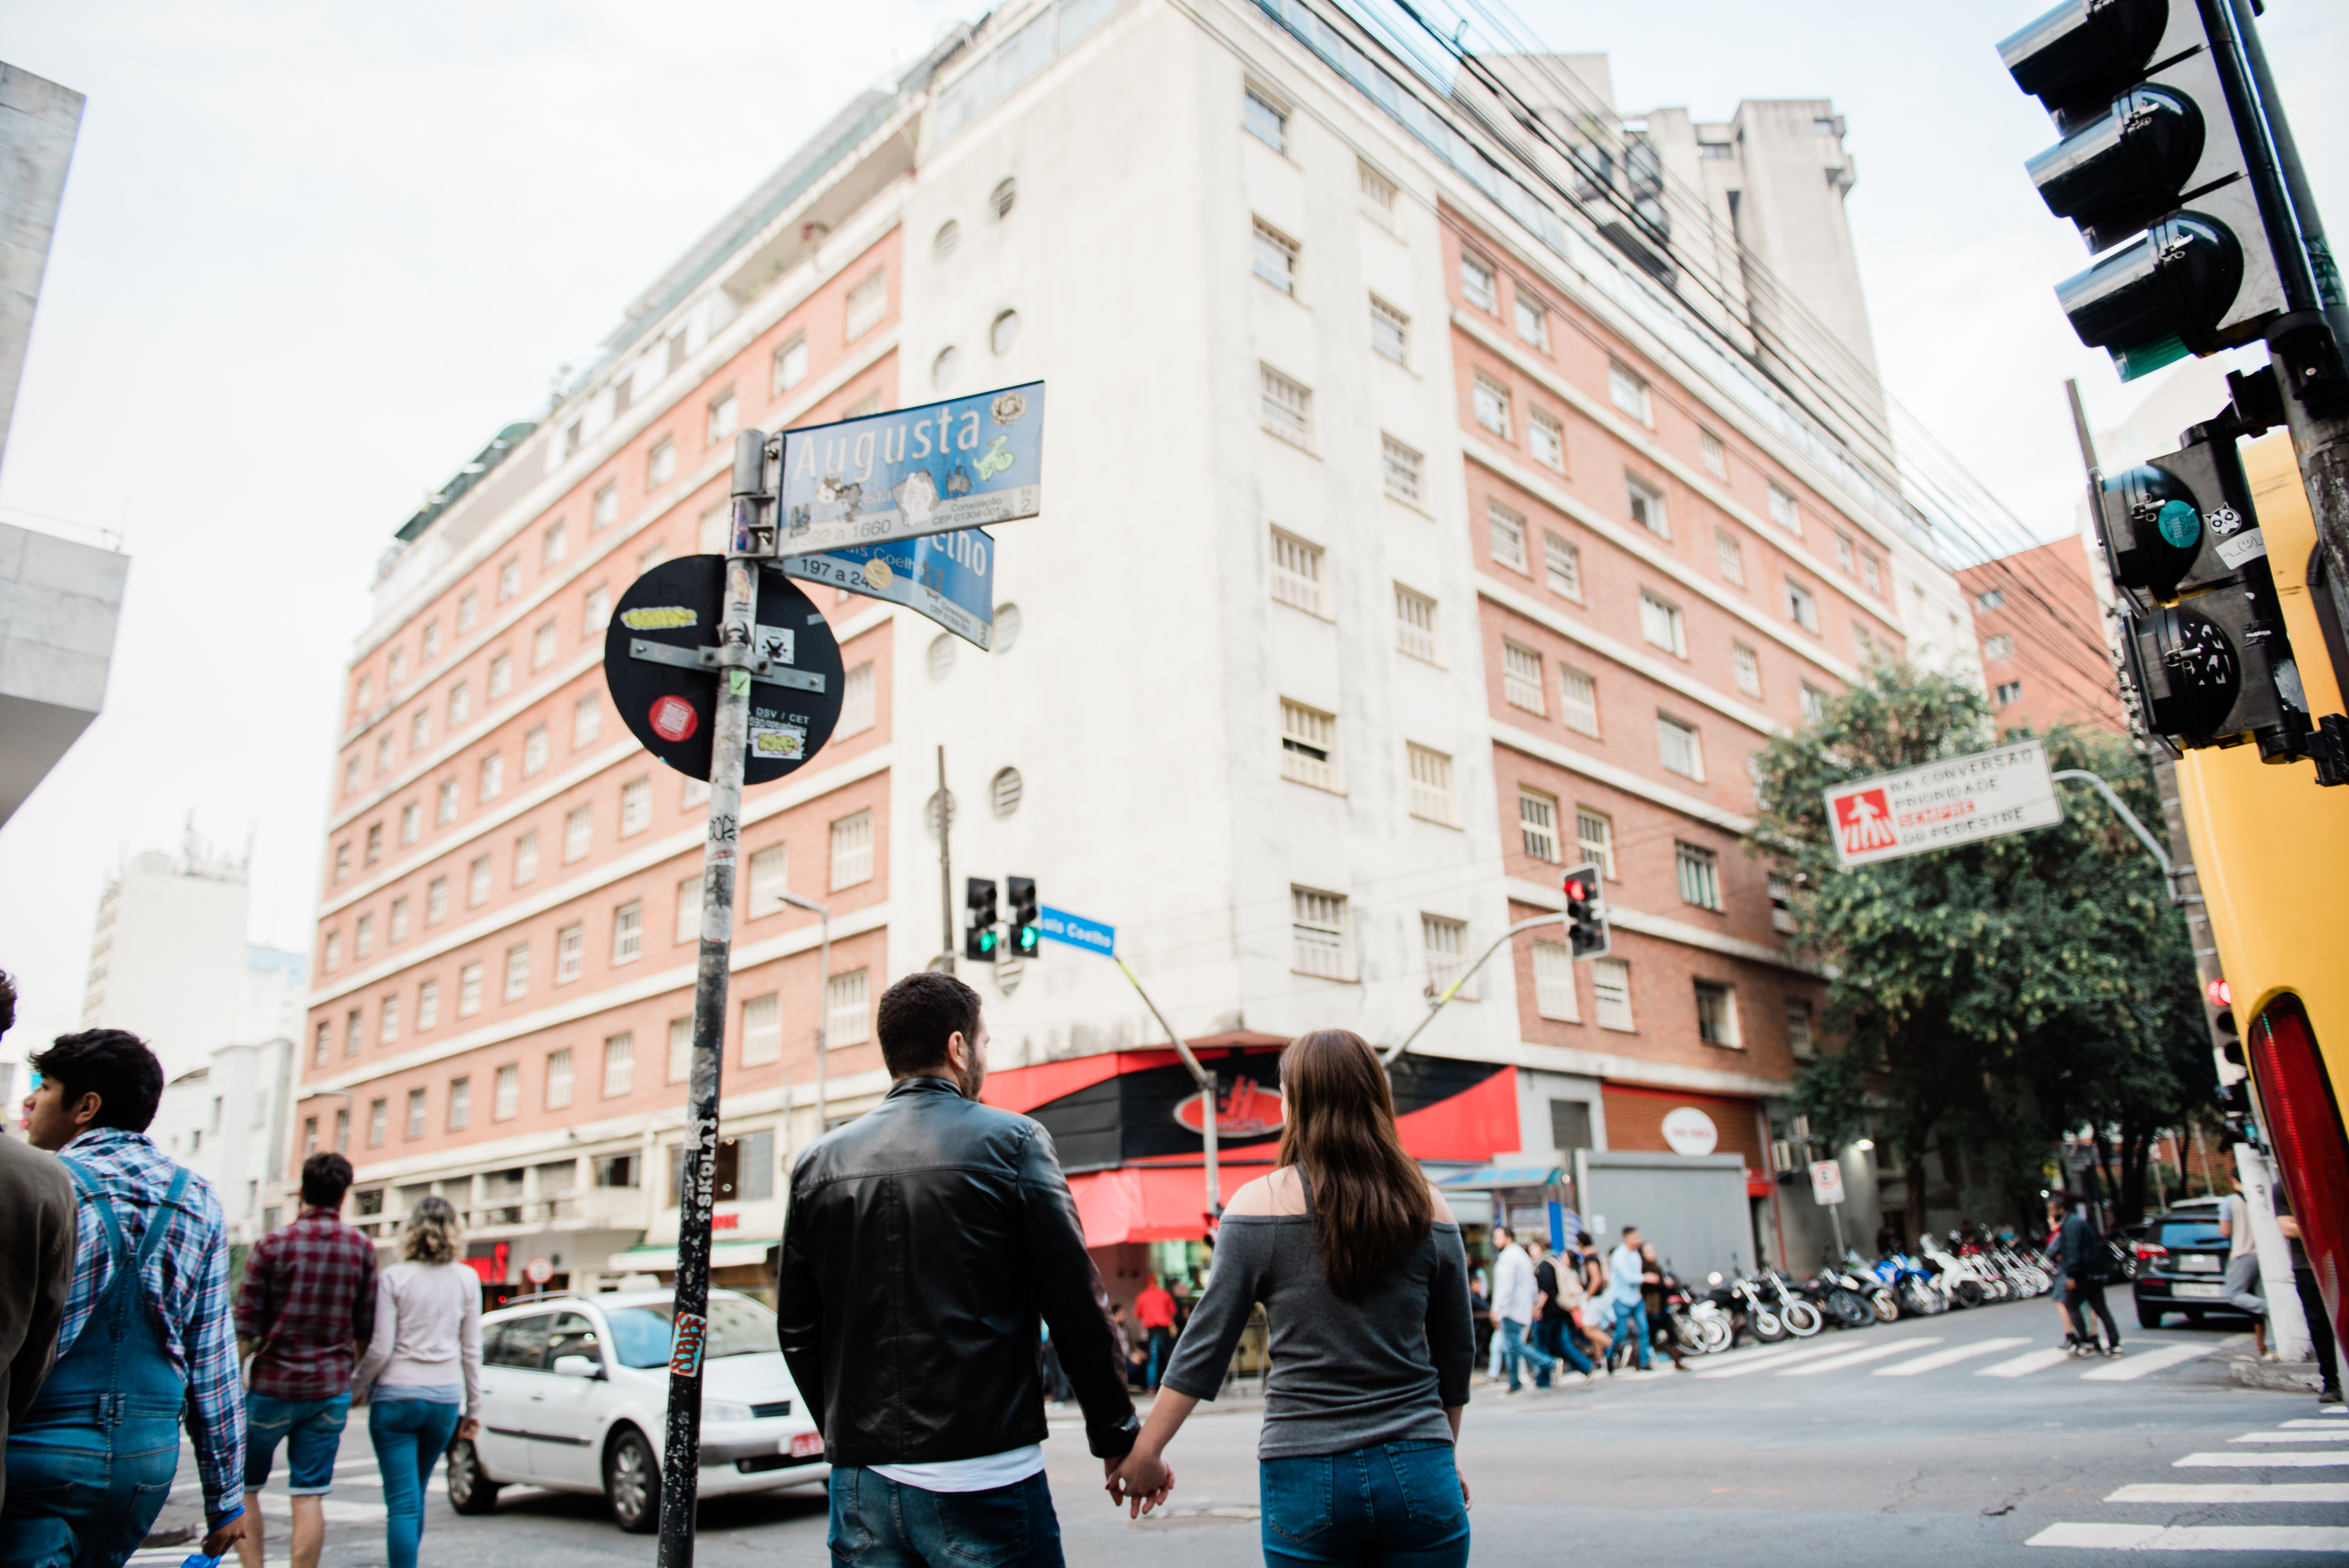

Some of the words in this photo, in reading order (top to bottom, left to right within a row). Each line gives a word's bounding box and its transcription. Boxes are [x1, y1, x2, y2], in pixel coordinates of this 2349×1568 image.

[793, 406, 980, 483] Augusta
[951, 497, 1002, 512] Consolação
[1021, 498, 1031, 513] 2
[836, 529, 845, 542] a
[852, 519, 891, 538] 1660
[932, 514, 952, 526] CEP
[801, 558, 831, 577] 197
[836, 569, 845, 582] a
[851, 571, 879, 591] 24
[756, 707, 778, 718] DSV
[789, 714, 810, 724] CET
[1890, 780, 1913, 792] NA
[1895, 779, 2000, 810] PRIORIDADE
[1900, 800, 1975, 827] SEMPRE
[1903, 831, 1925, 845] DO
[1932, 807, 2026, 838] PEDESTRE
